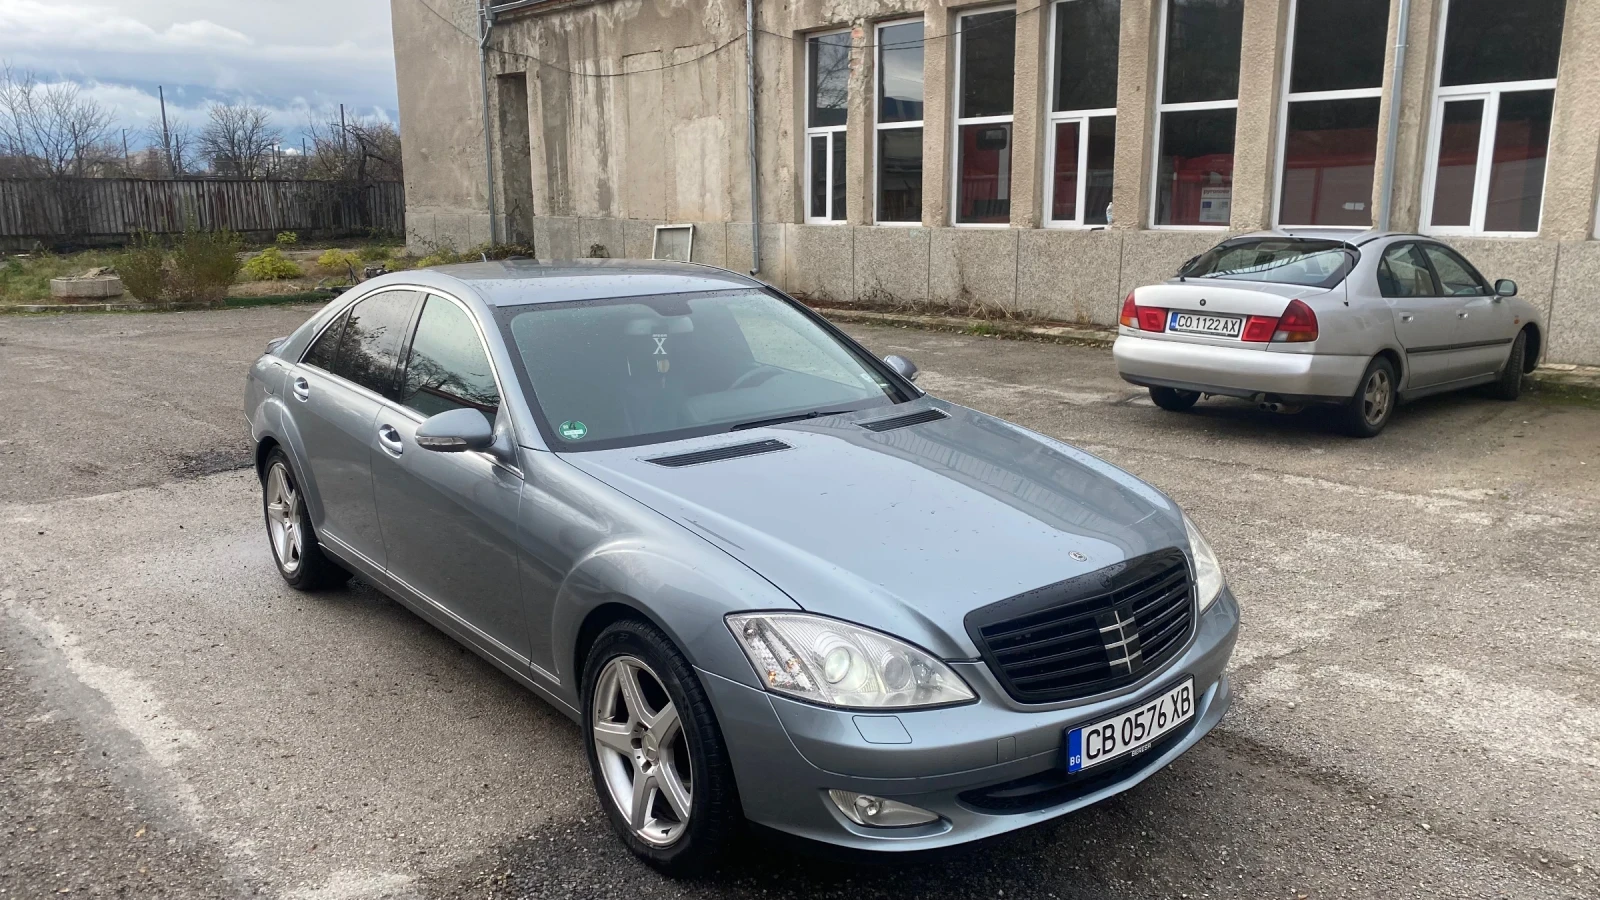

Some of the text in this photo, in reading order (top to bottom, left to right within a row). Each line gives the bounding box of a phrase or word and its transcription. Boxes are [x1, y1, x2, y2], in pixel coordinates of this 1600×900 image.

[1178, 315, 1193, 328] CO
[1196, 317, 1221, 331] 1122
[1222, 320, 1238, 333] AX
[653, 338, 667, 354] X
[1086, 686, 1190, 760] CB 0576 XB
[1070, 754, 1080, 766] BG
